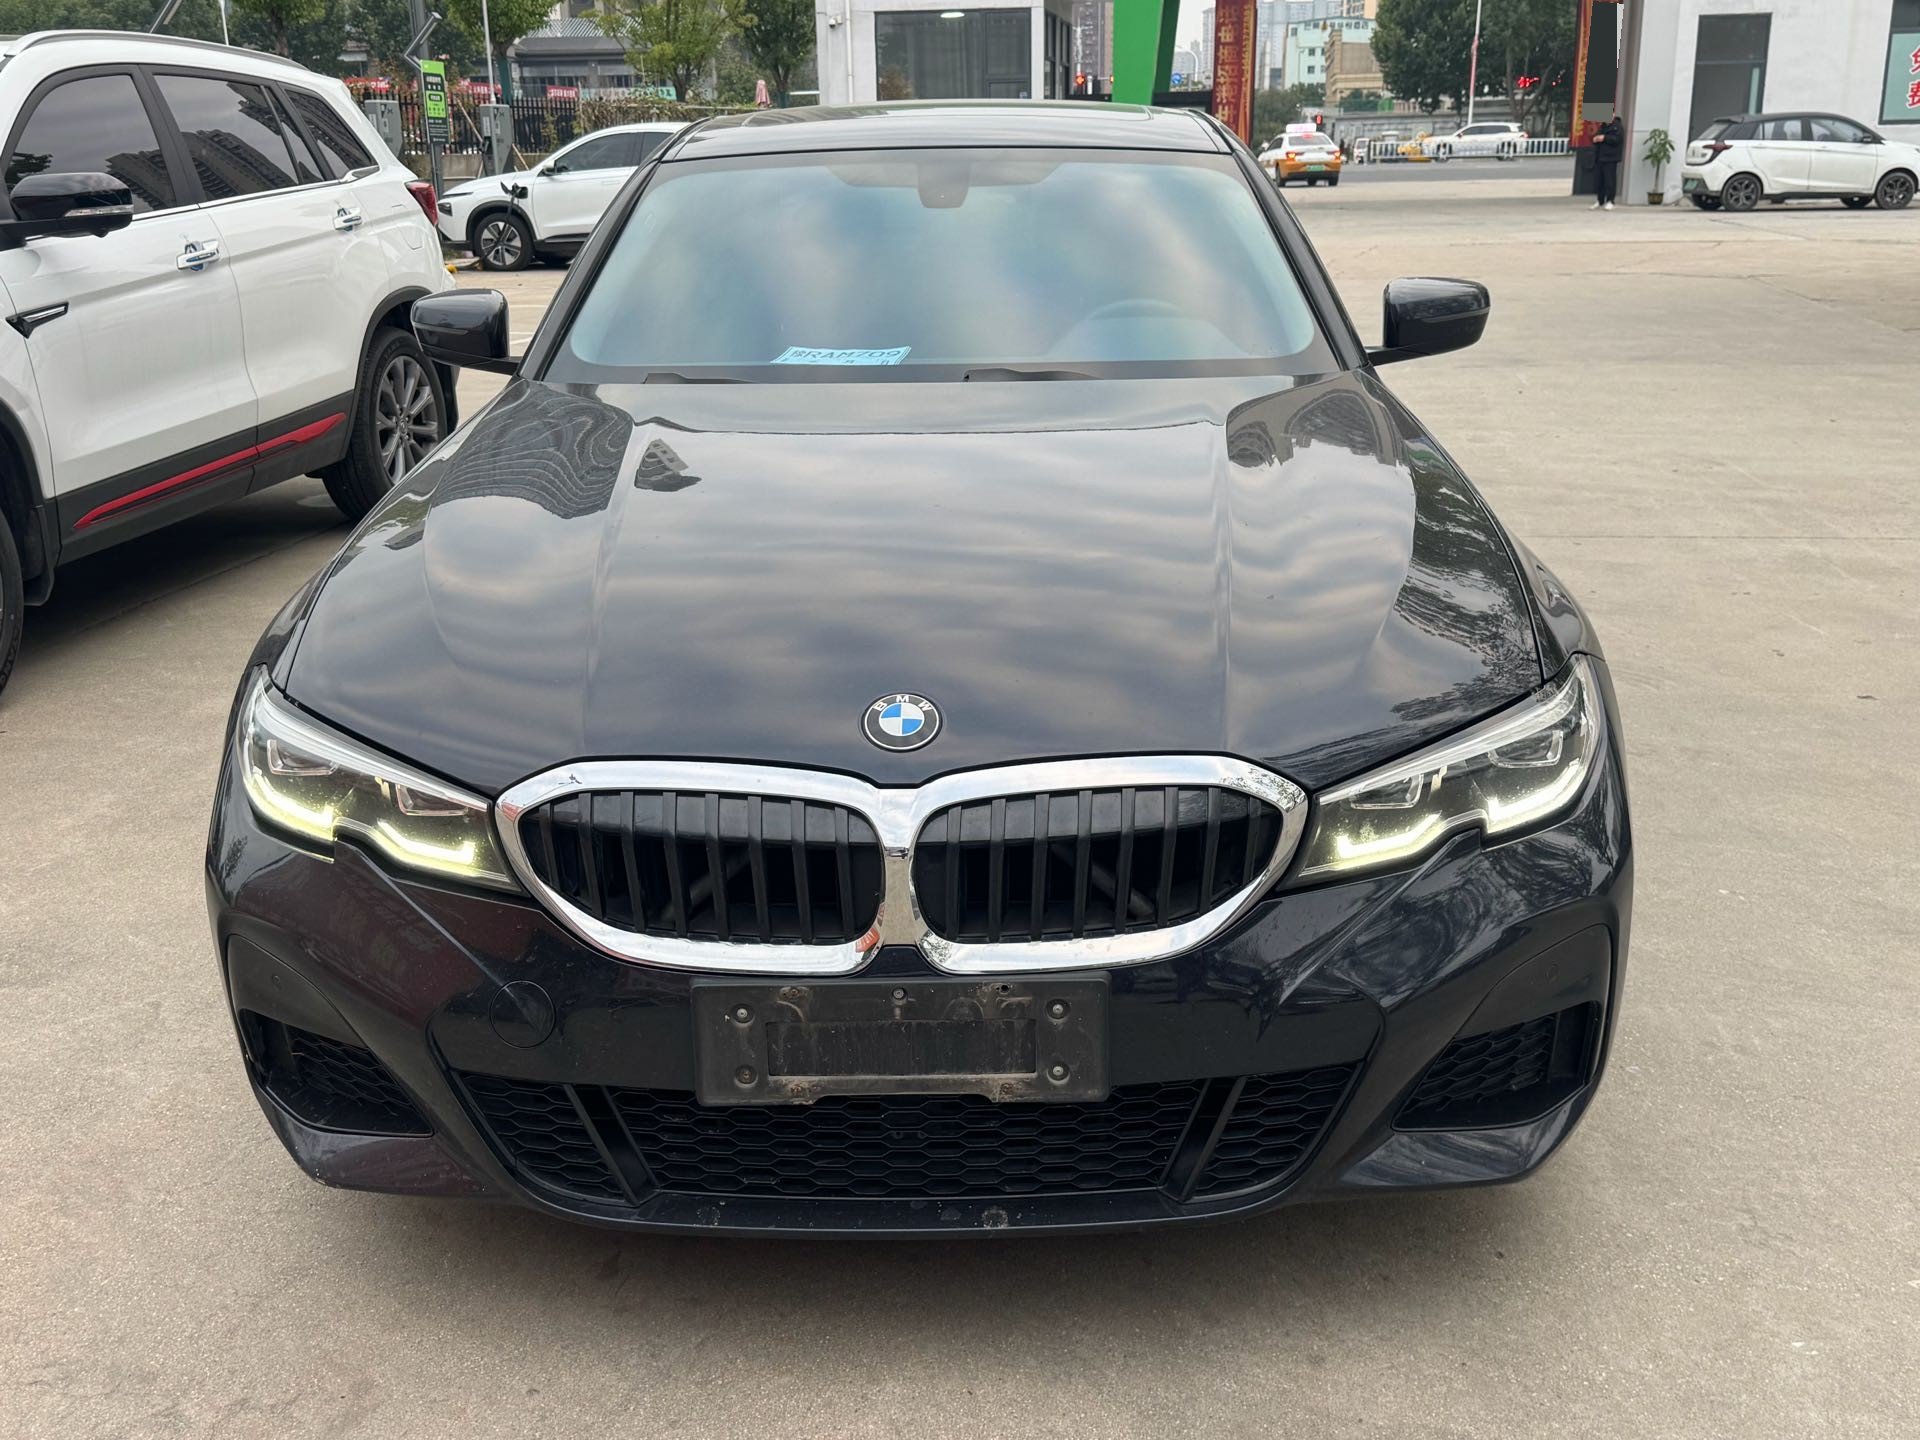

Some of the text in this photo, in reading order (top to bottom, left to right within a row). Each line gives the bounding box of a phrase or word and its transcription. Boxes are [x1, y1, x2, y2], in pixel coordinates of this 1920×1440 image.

[1216, 4, 1239, 130] 车港招商电话
[872, 695, 933, 712] BMW
